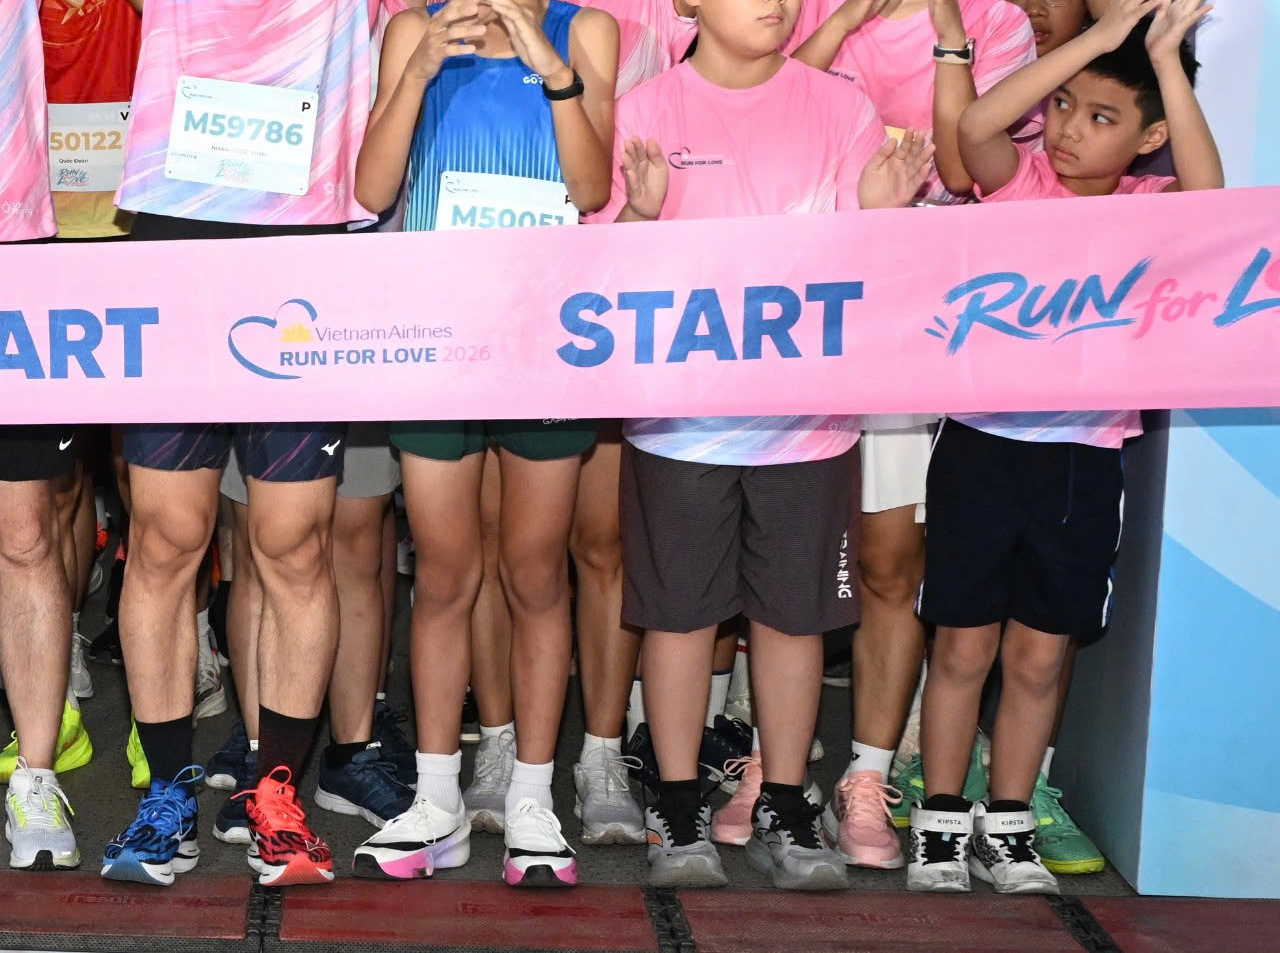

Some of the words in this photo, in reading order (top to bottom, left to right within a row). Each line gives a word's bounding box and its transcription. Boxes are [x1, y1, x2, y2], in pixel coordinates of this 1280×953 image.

[119, 111, 130, 121] V
[301, 102, 311, 112] P
[183, 109, 305, 146] M59786
[1132, 278, 1218, 340] for
[554, 280, 865, 368] START
[279, 350, 328, 368] RUN
[333, 349, 376, 366] FOR
[382, 346, 438, 365] LOVE
[441, 345, 491, 364] 2026
[937, 818, 962, 826] KIPSTA
